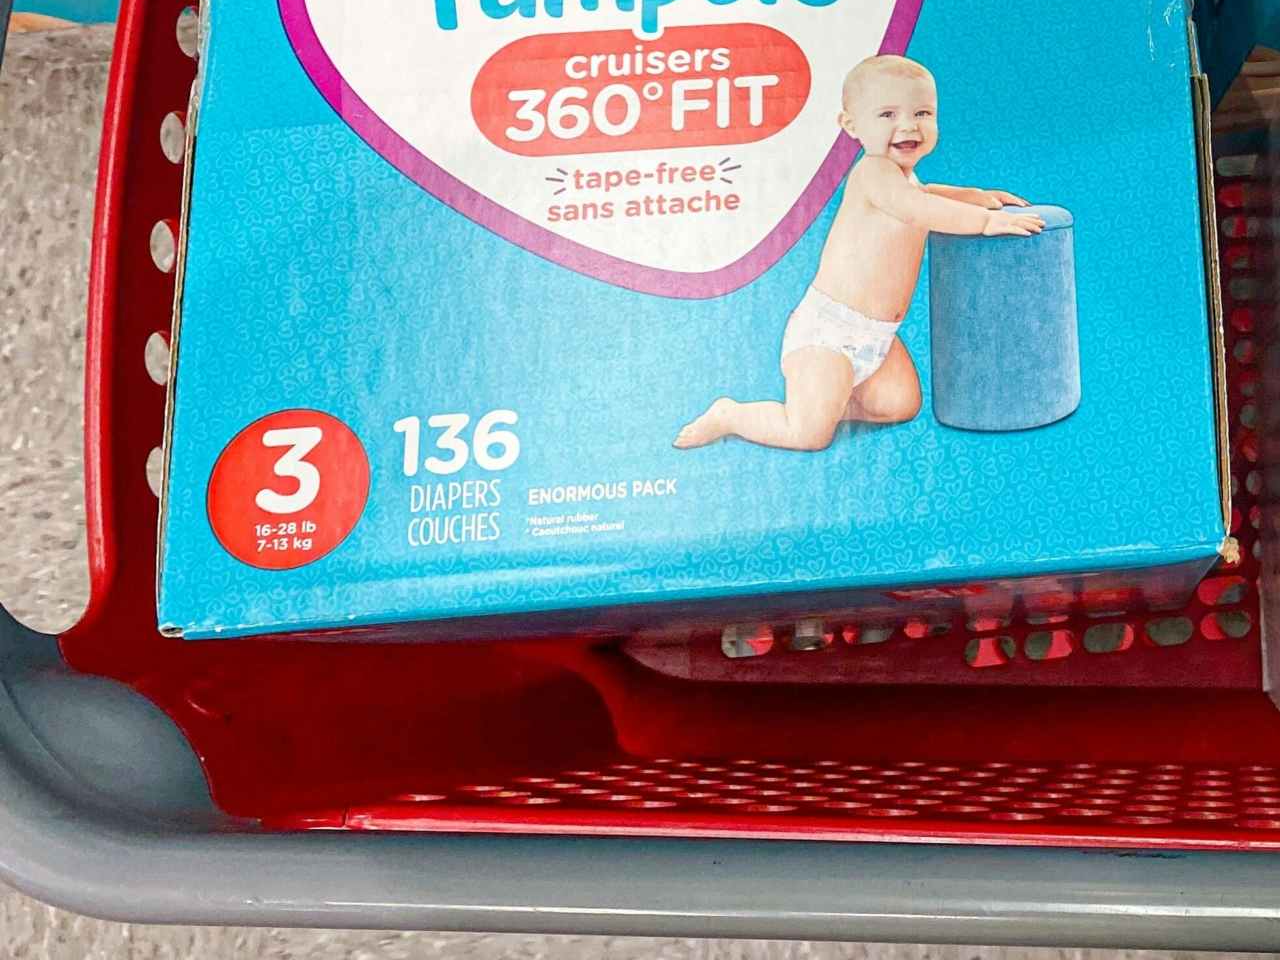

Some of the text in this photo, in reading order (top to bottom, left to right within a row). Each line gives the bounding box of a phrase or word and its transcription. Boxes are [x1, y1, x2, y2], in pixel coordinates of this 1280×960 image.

[564, 45, 731, 80] cruisers
[573, 159, 716, 194] tape-free
[546, 189, 741, 223] sans attache
[255, 410, 520, 515] 3 136
[409, 480, 501, 514] DIAPERS
[527, 478, 677, 506] ENORMOUS PACK
[255, 520, 317, 537] 16-28 lb
[256, 536, 313, 553] 7-13 kg
[407, 512, 501, 547] COUCHES
